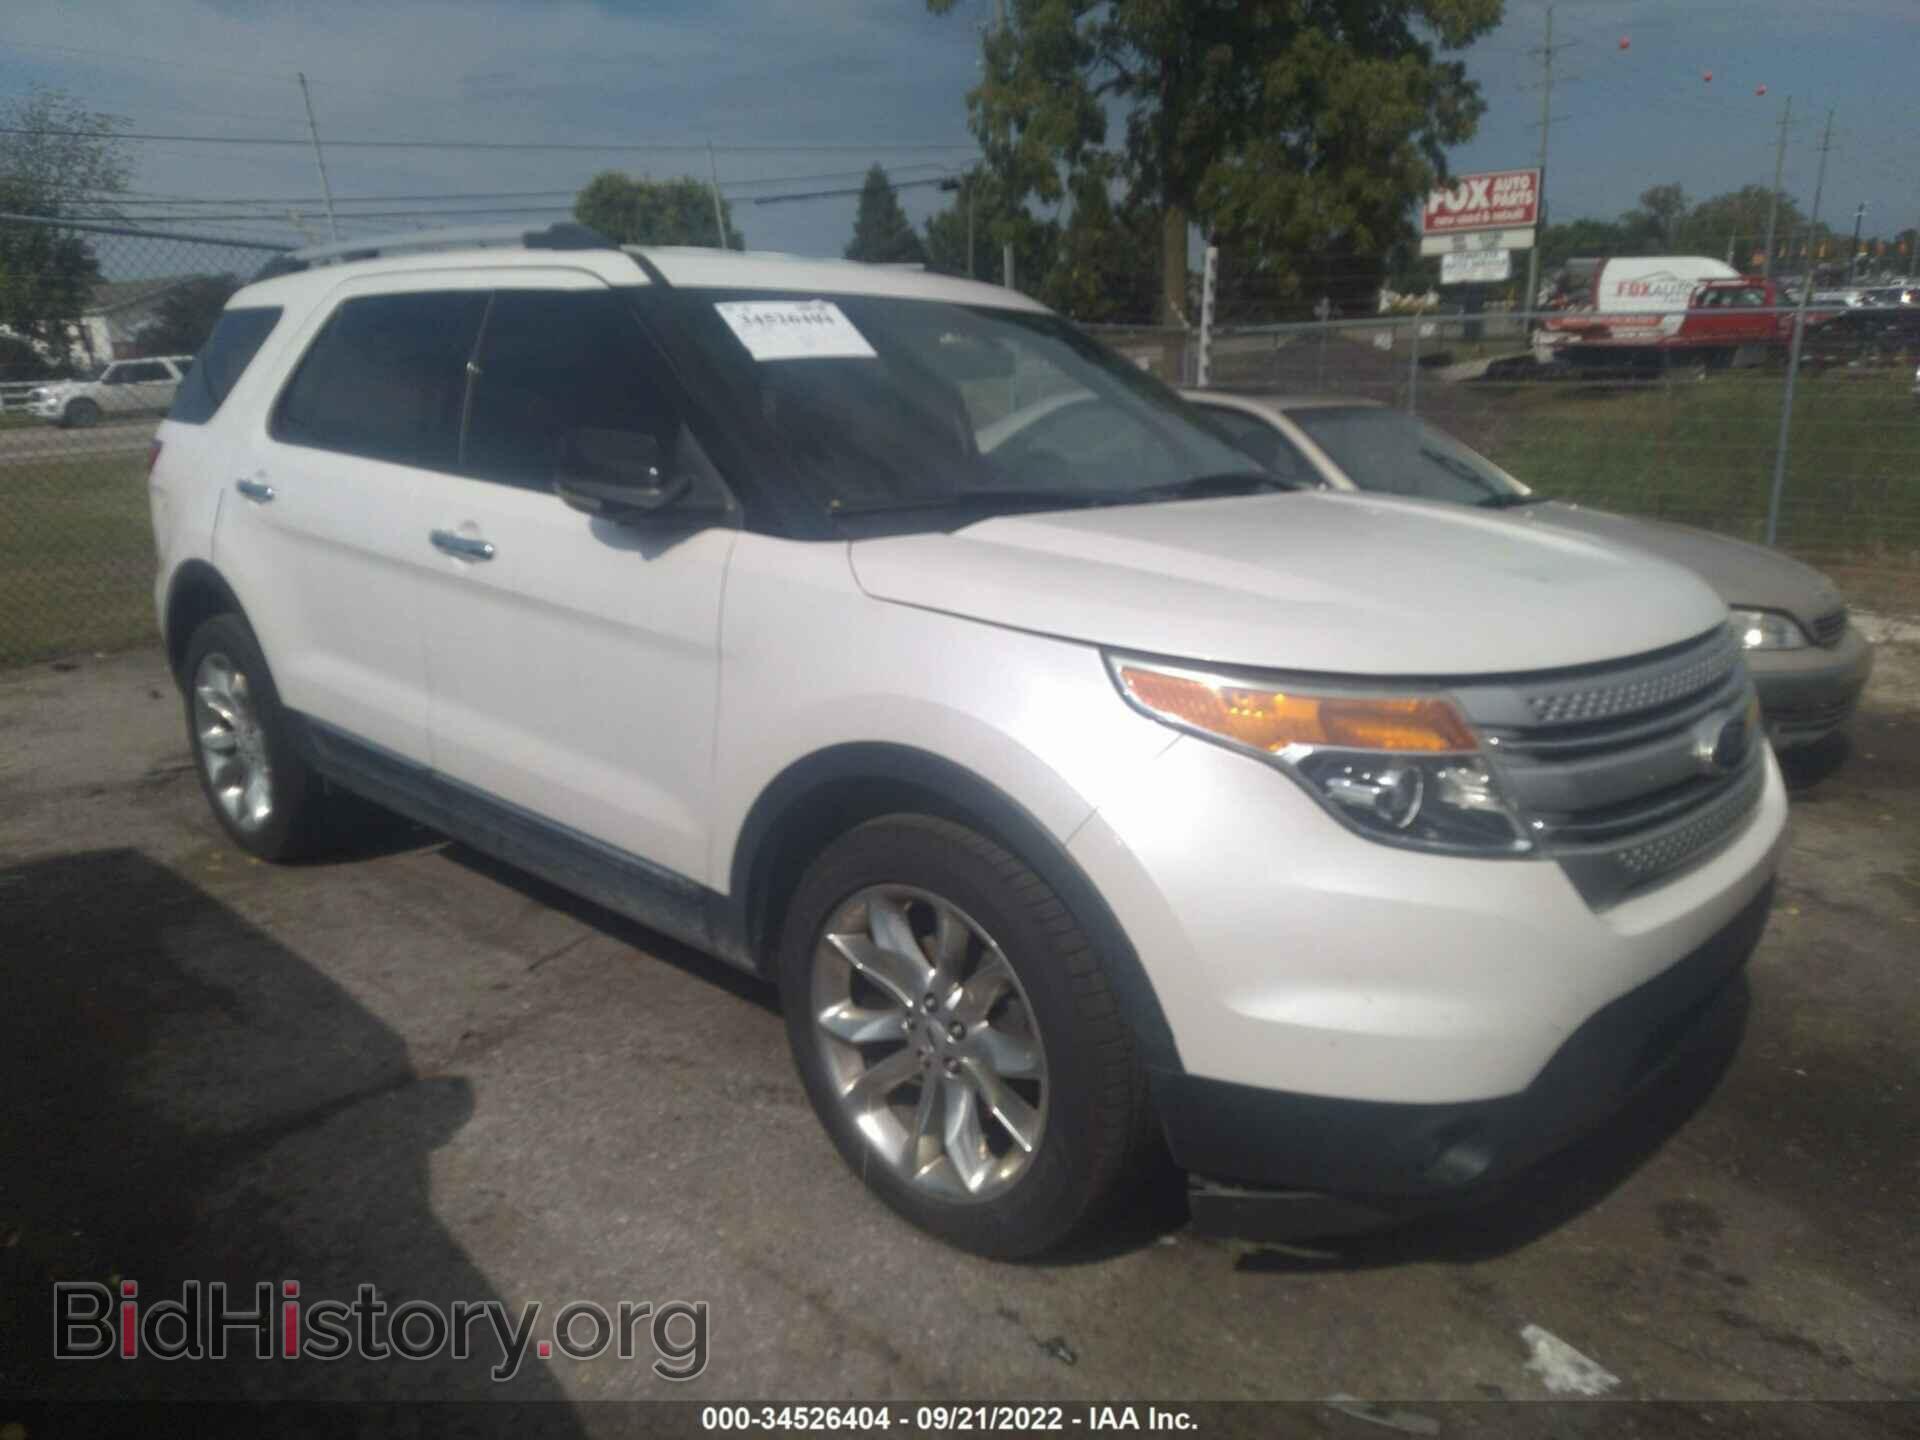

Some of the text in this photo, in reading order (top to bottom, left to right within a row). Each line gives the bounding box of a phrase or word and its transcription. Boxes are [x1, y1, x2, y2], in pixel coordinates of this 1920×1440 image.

[1494, 175, 1530, 192] AUTO
[1428, 179, 1490, 214] FOX
[1491, 189, 1534, 208] PARTS
